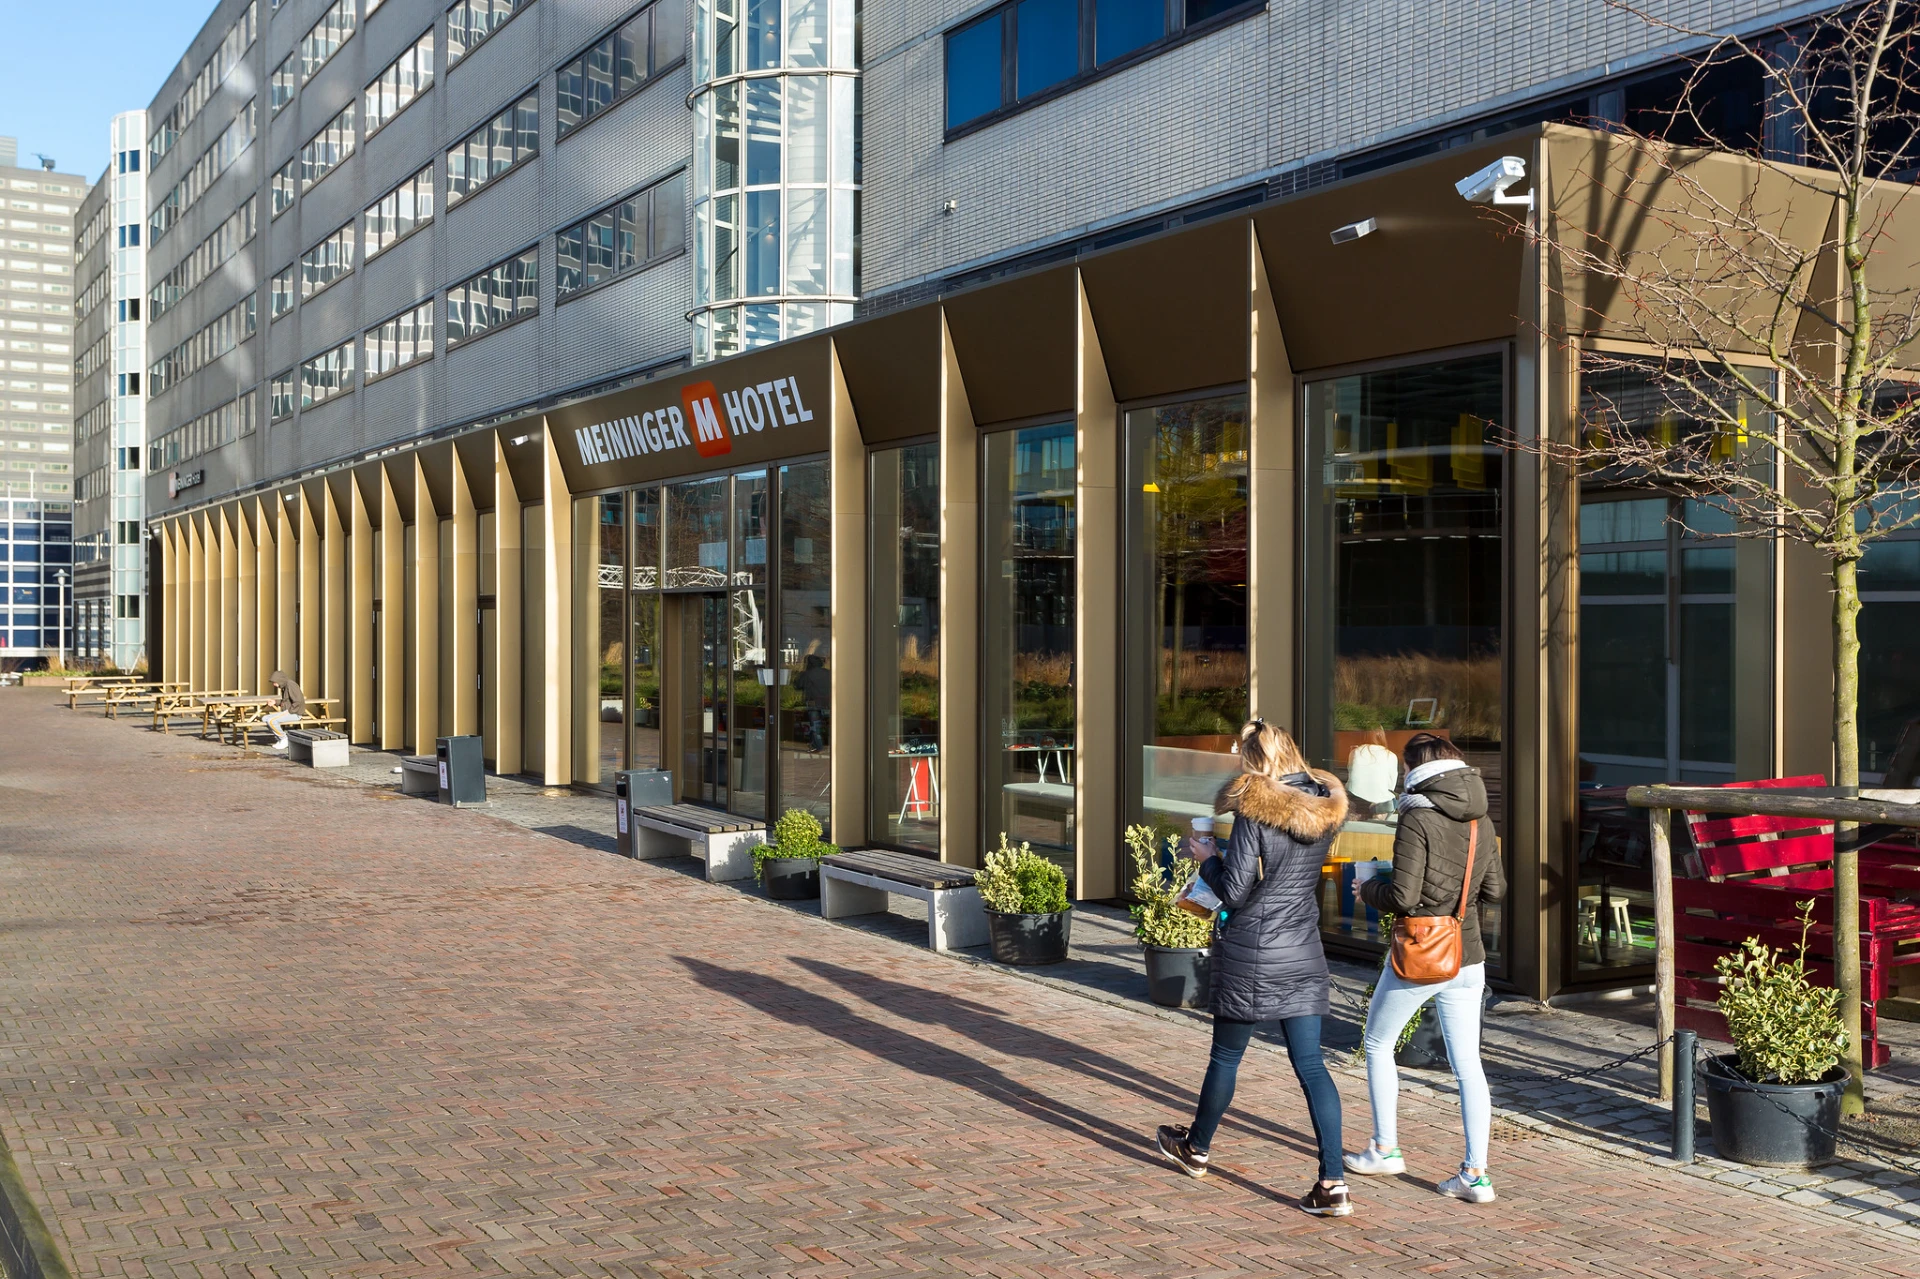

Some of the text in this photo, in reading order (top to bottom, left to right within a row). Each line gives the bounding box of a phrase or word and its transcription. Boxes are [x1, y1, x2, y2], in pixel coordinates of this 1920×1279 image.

[575, 376, 814, 466] MEININGER M HOTEL
